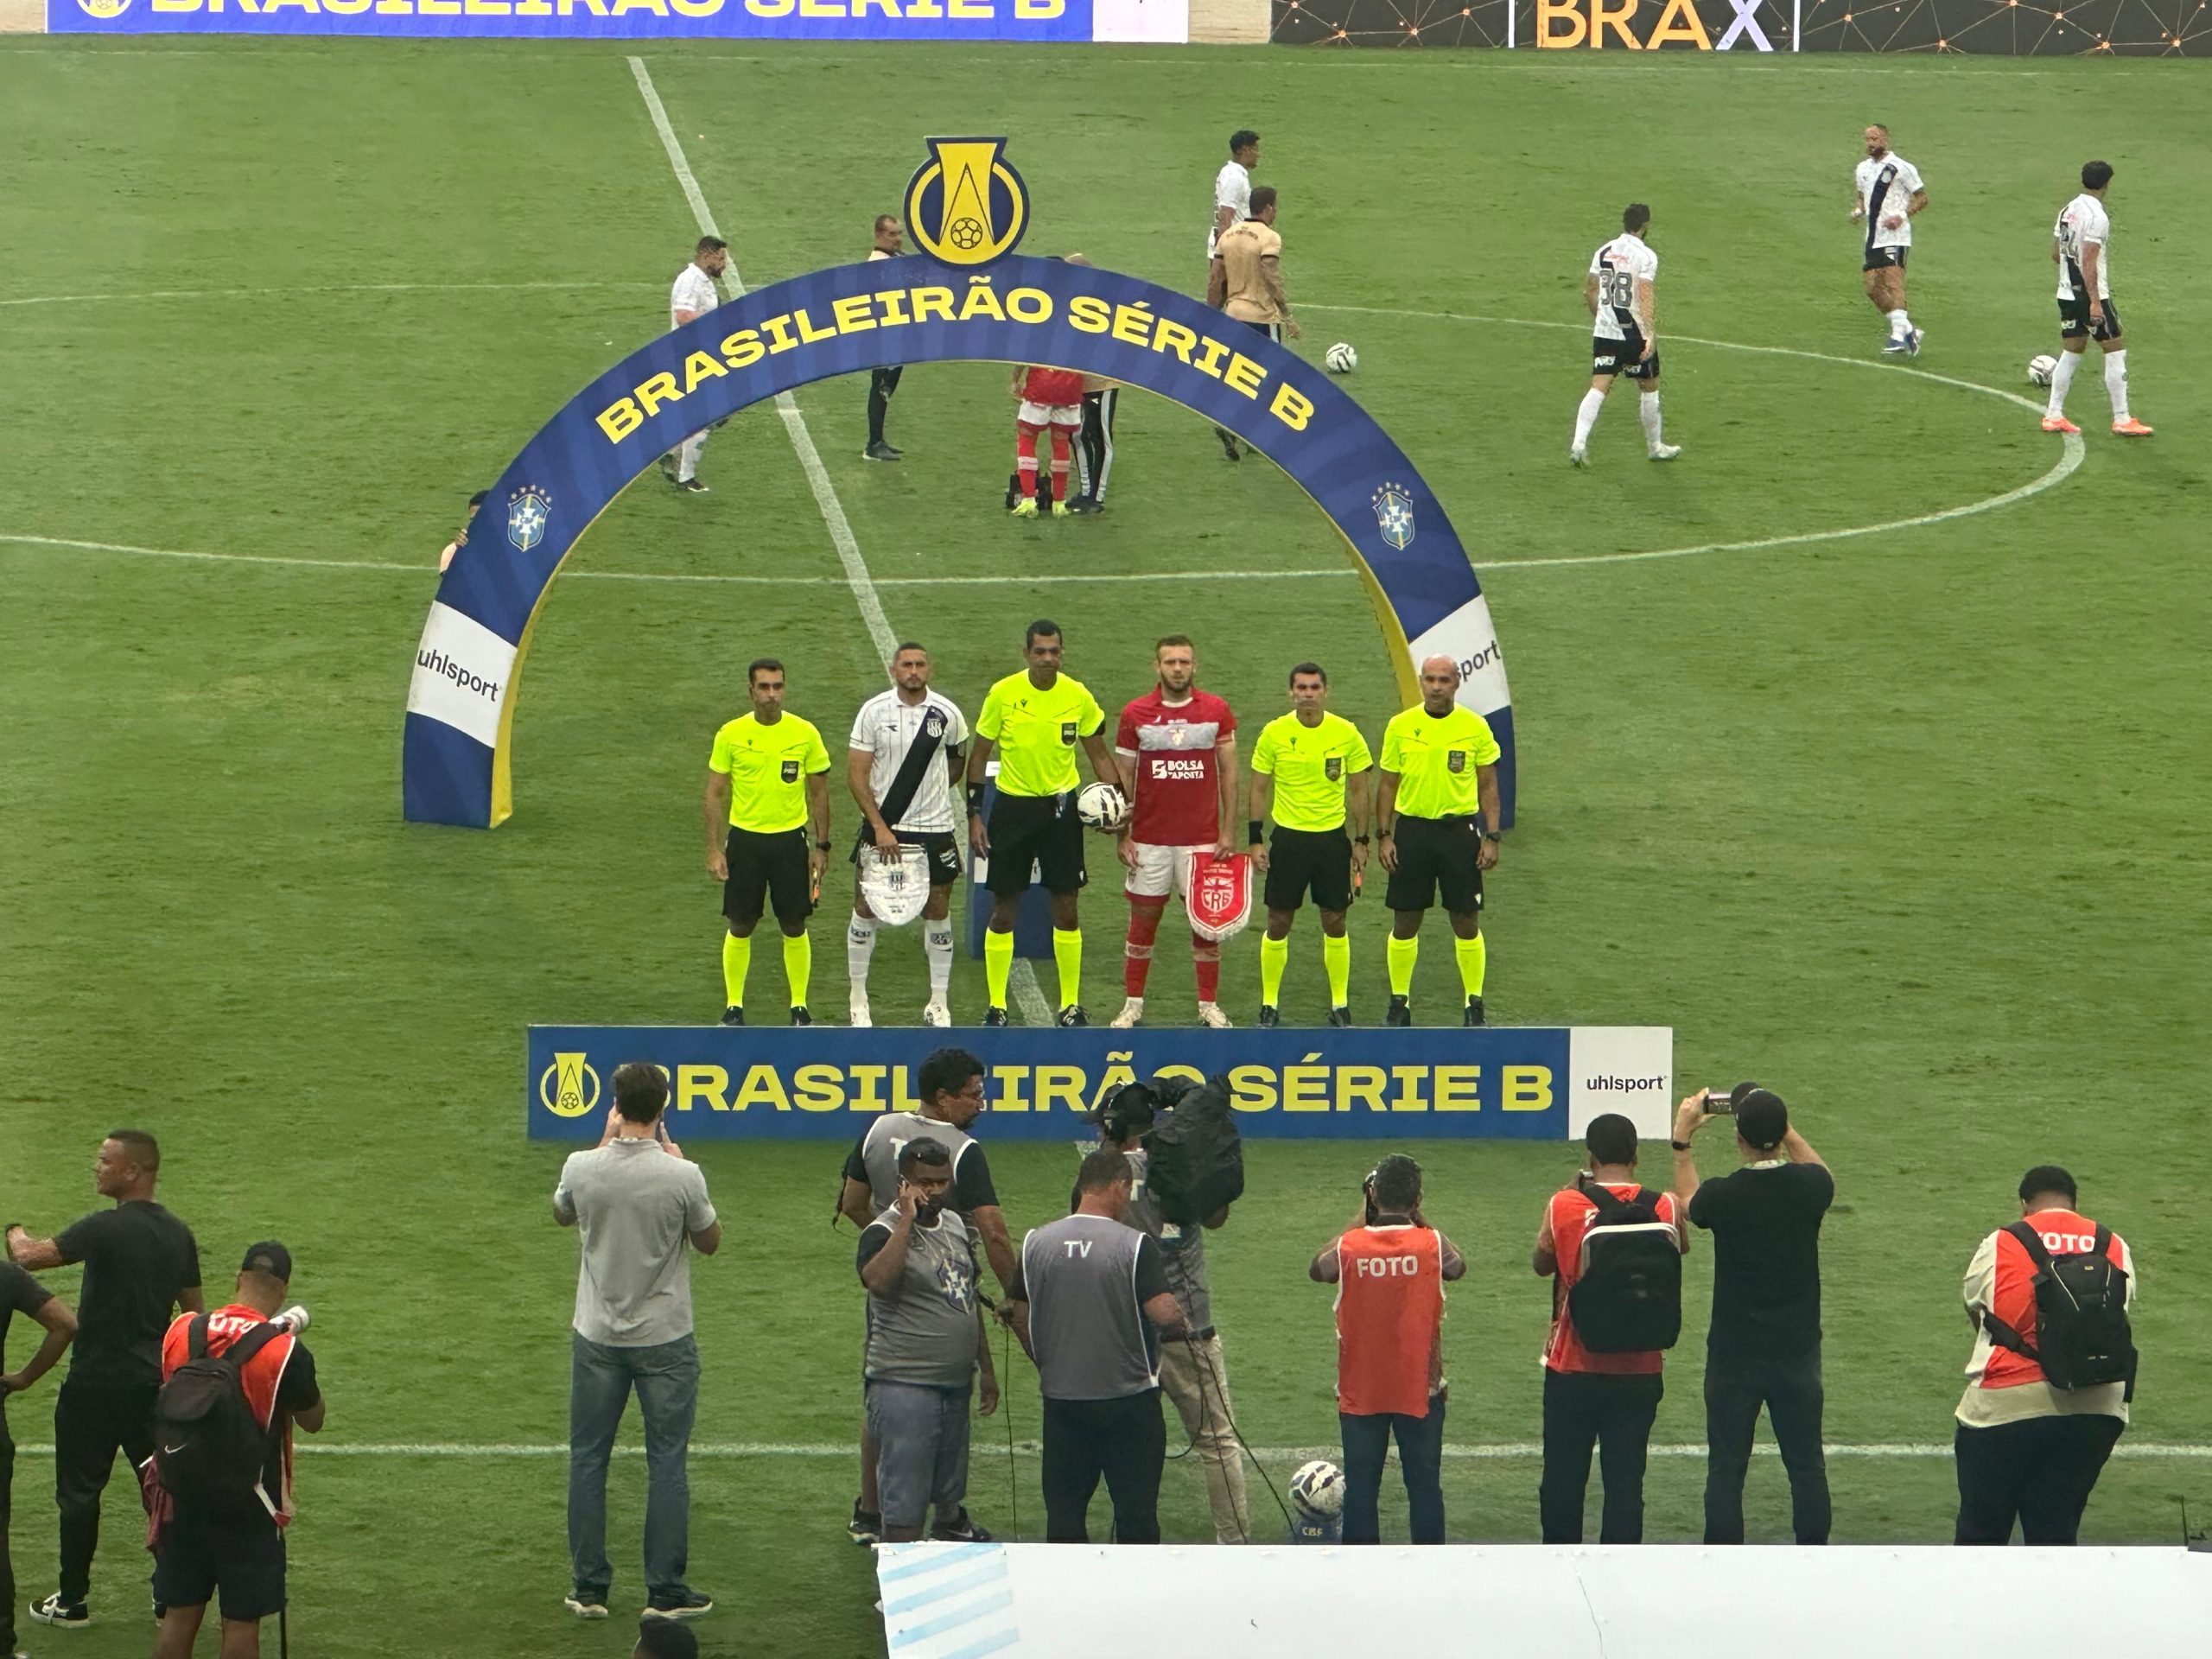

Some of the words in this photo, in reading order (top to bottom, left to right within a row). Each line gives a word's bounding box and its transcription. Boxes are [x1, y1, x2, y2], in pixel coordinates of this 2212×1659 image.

[1536, 0, 1774, 51] BRAX
[595, 275, 1053, 444] BRASILEIRÃO
[1068, 296, 1268, 400] SÉRIE
[1269, 382, 1314, 431] B
[417, 648, 499, 702] uhlsport
[1167, 760, 1204, 771] BOLSA
[619, 1051, 1206, 1112] RASILIRÃ
[1228, 1052, 1481, 1112] SÉRIE
[1502, 1065, 1553, 1111] B
[1586, 1075, 1664, 1093] uhlsport
[1064, 1240, 1093, 1258] TV
[2037, 1231, 2095, 1253] OTO
[1357, 1255, 1418, 1278] FOTO
